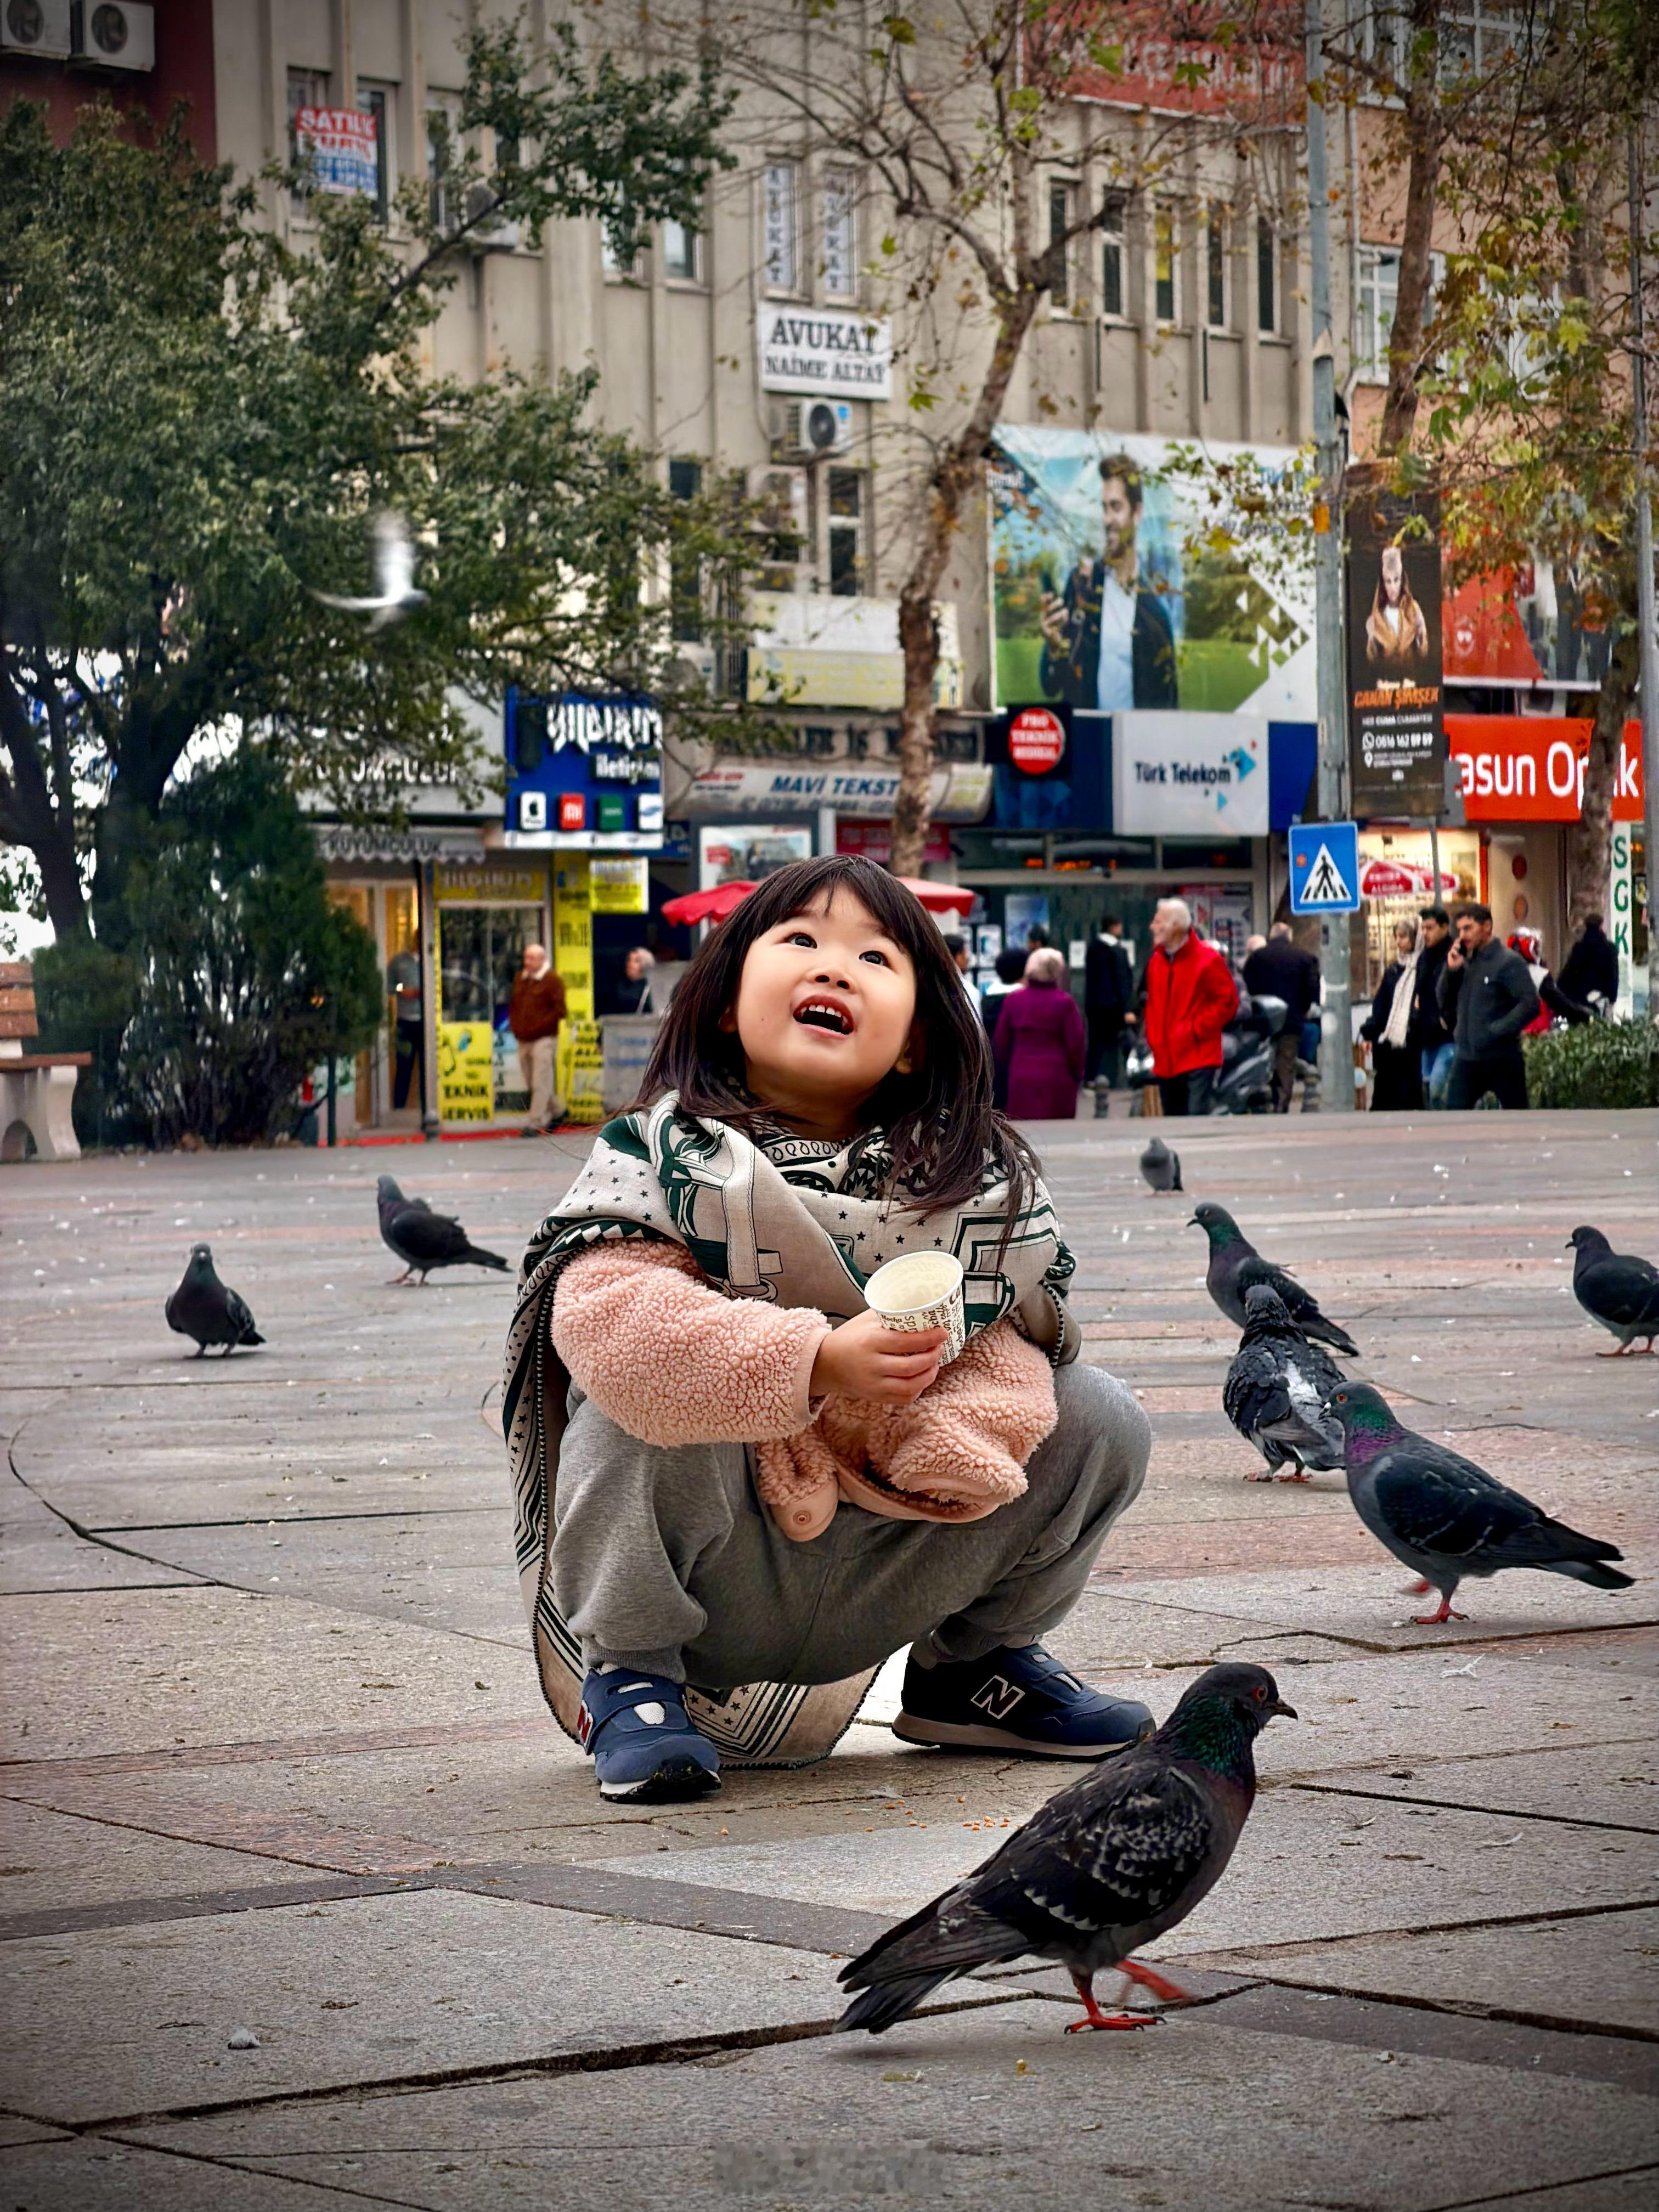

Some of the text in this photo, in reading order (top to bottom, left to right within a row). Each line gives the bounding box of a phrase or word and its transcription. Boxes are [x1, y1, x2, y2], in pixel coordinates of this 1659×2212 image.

[771, 317, 878, 354] AVUKAT
[833, 777, 901, 795] TEKST
[1135, 761, 1231, 784] Türk Telekom
[1449, 741, 1639, 811] asun Opk
[970, 1675, 1025, 1719] N
